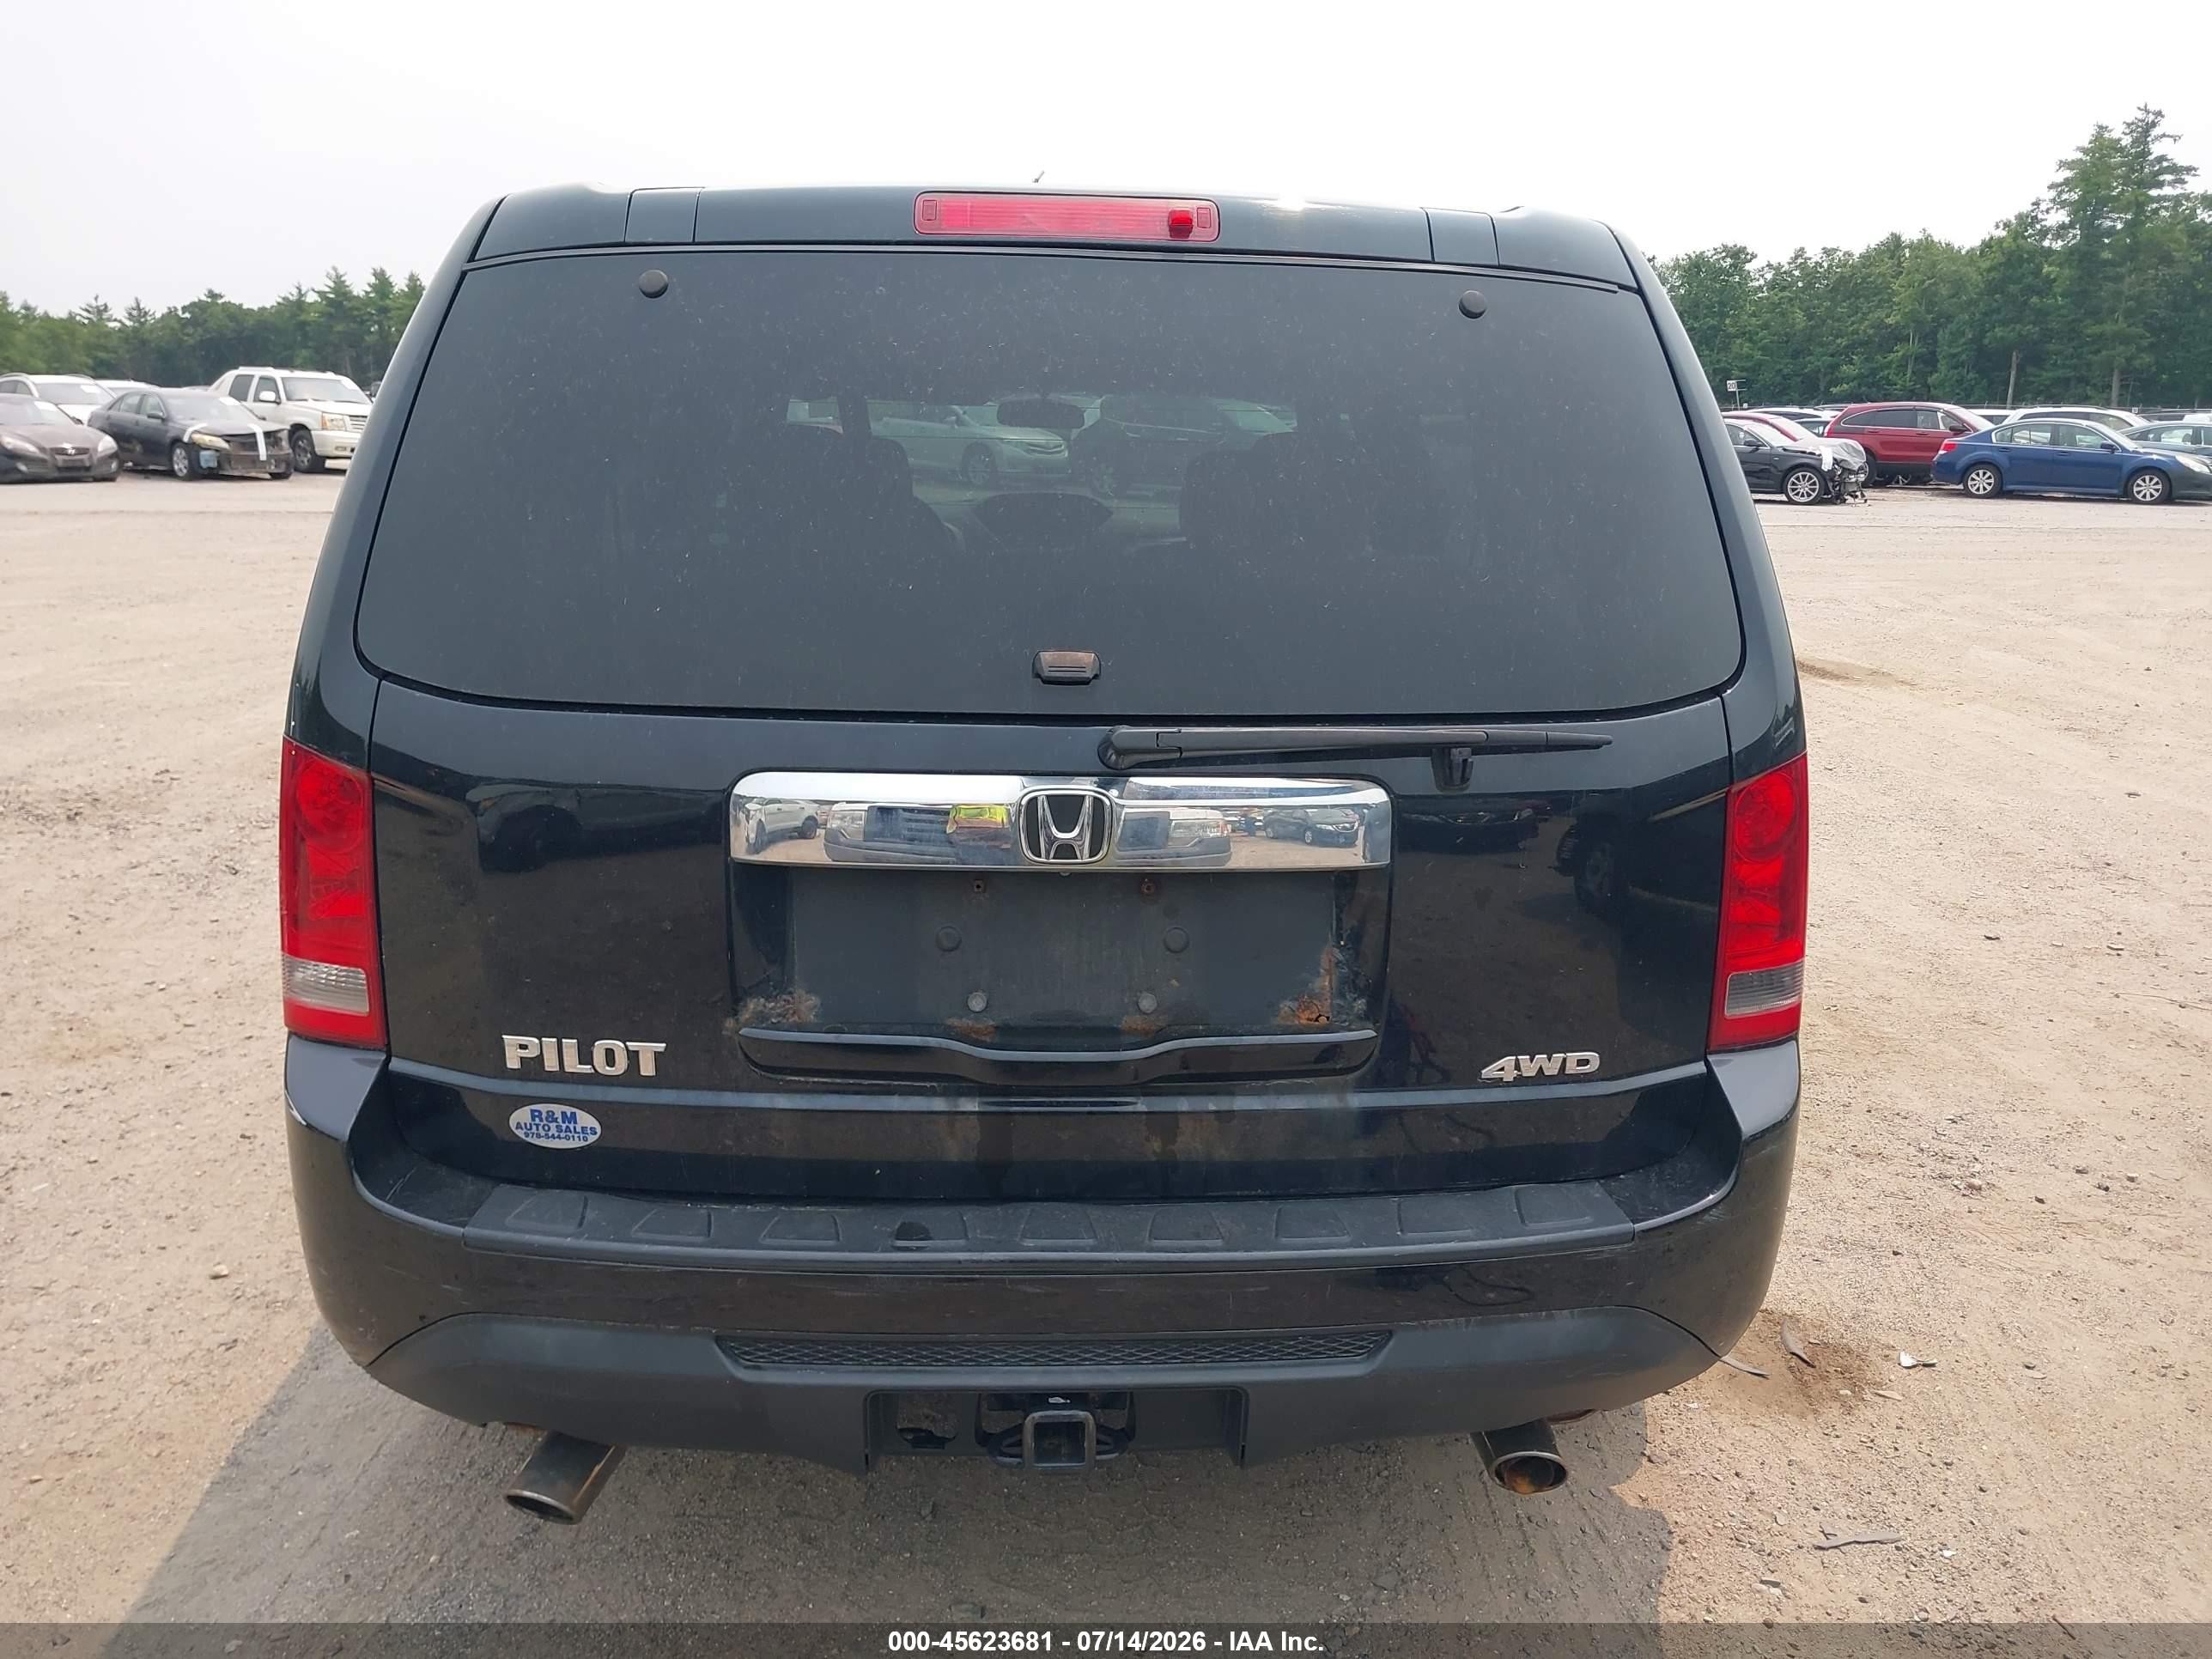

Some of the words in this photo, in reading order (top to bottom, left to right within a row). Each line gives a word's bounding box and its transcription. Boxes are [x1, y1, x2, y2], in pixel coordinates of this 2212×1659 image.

[501, 1034, 667, 1077] PILOT
[1481, 1051, 1601, 1082] 4WD
[515, 1121, 551, 1133] AUTO
[555, 1124, 598, 1135] SALES
[529, 1109, 578, 1125] R&M
